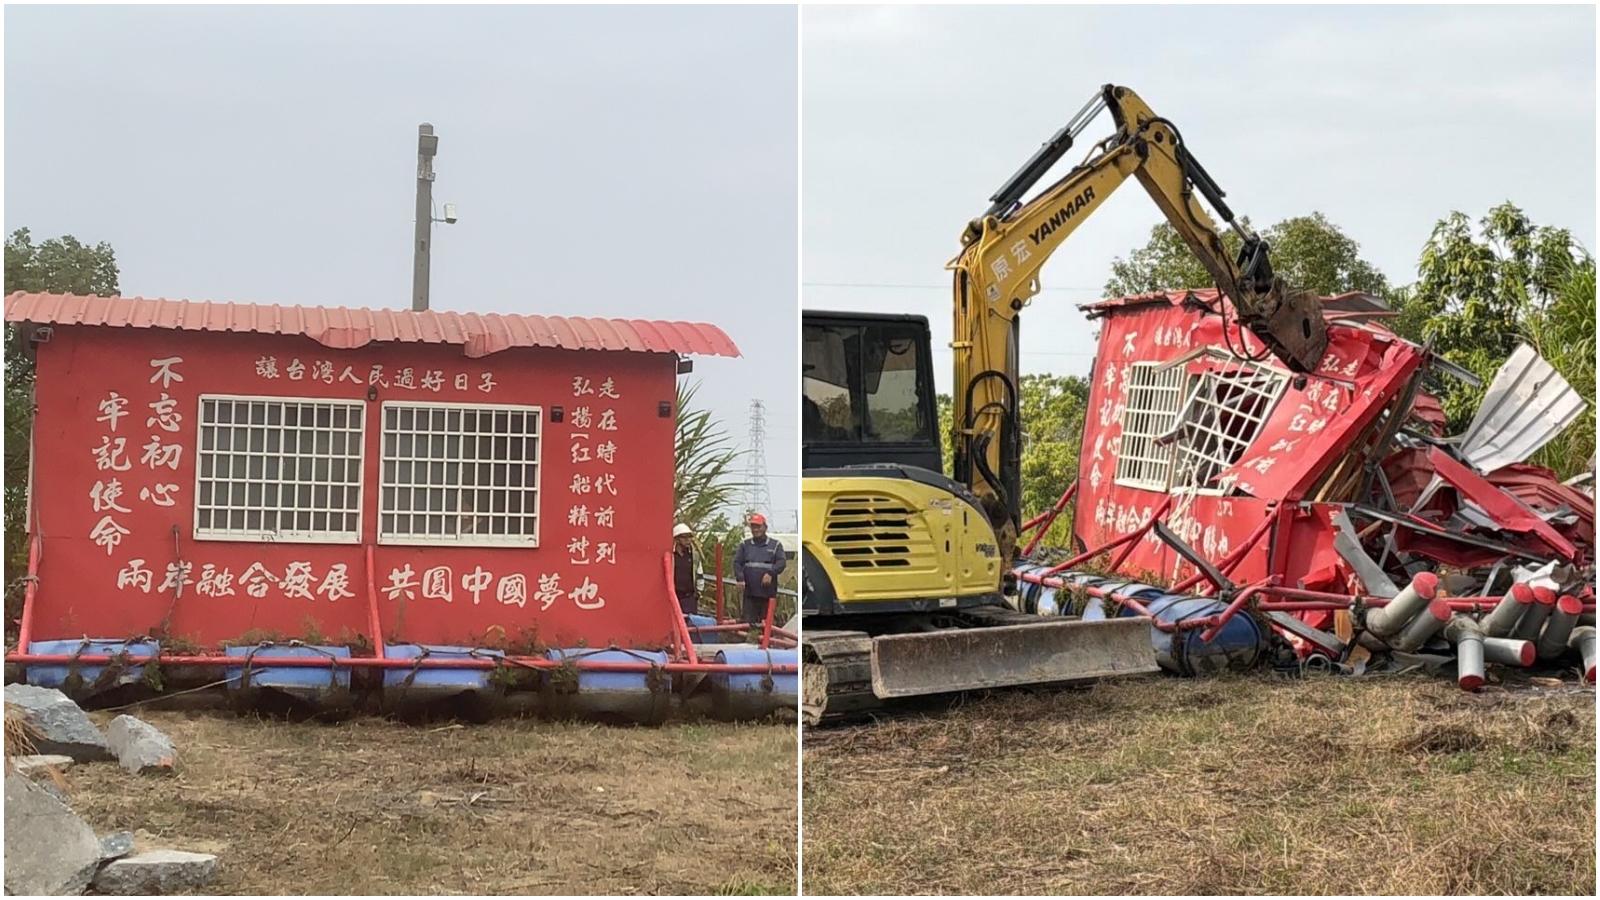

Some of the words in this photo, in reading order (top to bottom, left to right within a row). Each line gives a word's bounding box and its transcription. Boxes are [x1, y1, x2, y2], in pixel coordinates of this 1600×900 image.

[1029, 186, 1095, 246] YANMAR
[255, 356, 497, 392] 讓台灣人民過好日子
[90, 392, 132, 555] 牢記使命
[140, 356, 184, 506] 不忘初心
[594, 376, 620, 565] 走在時代前列
[117, 559, 356, 601] 兩岸融合發展
[381, 564, 606, 611] 共圓中國夢也
